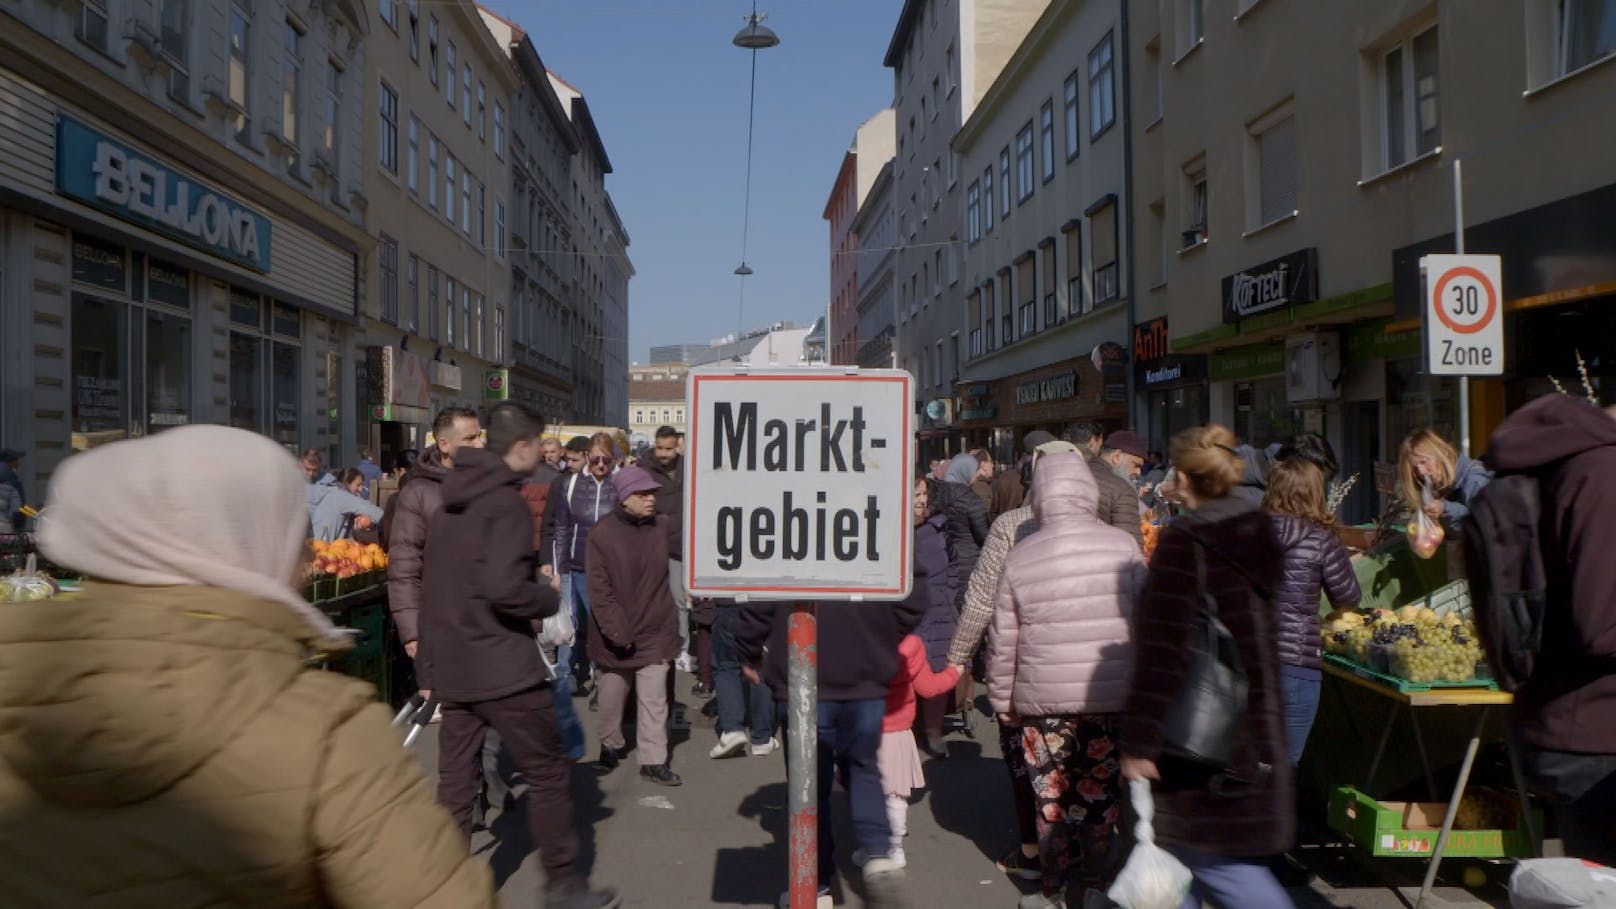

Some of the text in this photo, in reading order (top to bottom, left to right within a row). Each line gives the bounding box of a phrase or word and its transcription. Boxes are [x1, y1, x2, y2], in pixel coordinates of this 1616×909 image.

[92, 141, 260, 261] BELLONA
[1452, 286, 1478, 316] 30
[1145, 363, 1182, 384] Konditorei
[1442, 340, 1493, 365] Zone
[713, 402, 887, 472] Markt-
[717, 491, 880, 571] gebiet
